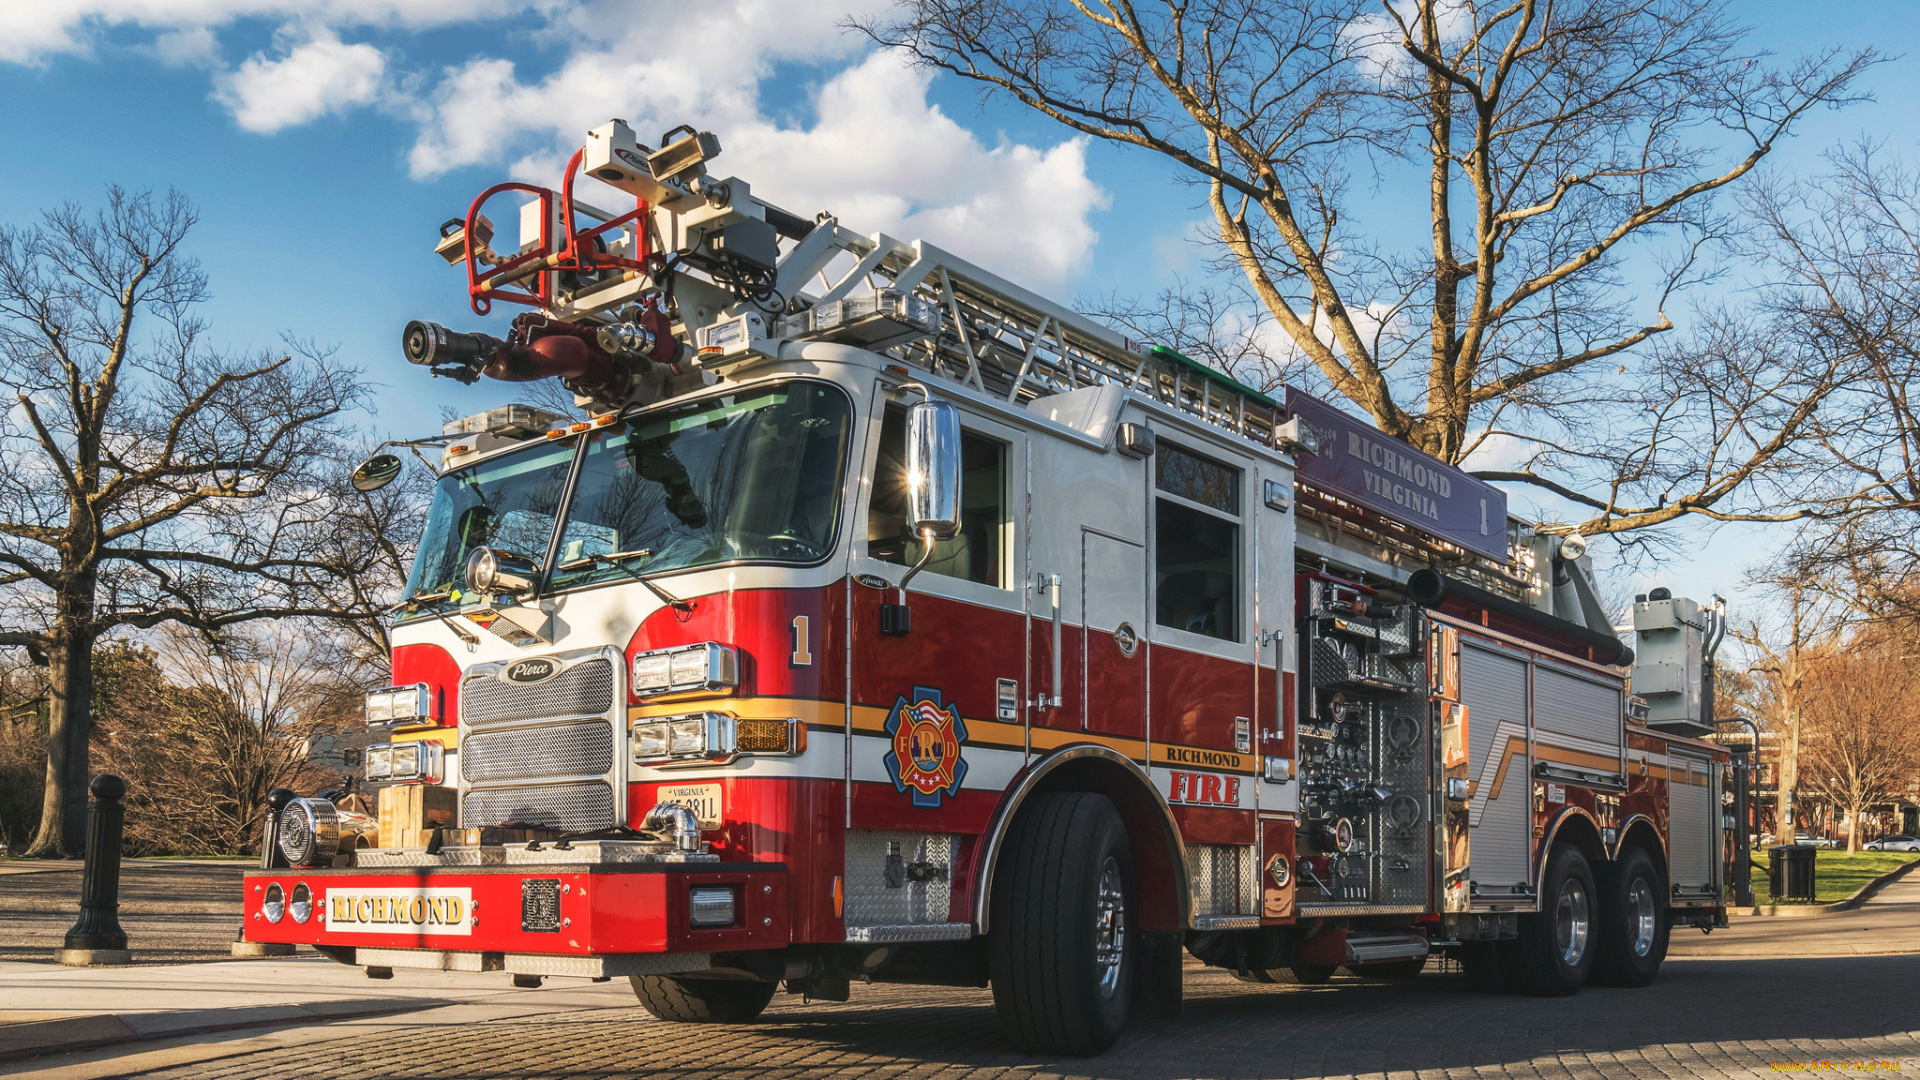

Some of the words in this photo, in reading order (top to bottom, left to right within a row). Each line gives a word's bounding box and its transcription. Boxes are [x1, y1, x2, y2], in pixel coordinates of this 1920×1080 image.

[1129, 341, 1141, 354] 105
[1347, 431, 1451, 498] RICHMOND
[1363, 469, 1438, 520] VIRGINIA
[1480, 499, 1488, 535] 1
[790, 615, 811, 667] 1
[511, 663, 548, 679] Pierce
[900, 736, 908, 753] F
[919, 729, 938, 762] R
[946, 741, 956, 758] D
[1166, 747, 1240, 767] RICHMOND
[673, 788, 705, 797] VIRGINIA
[1168, 770, 1240, 807] FIRE
[332, 895, 464, 925] RICHMOND
